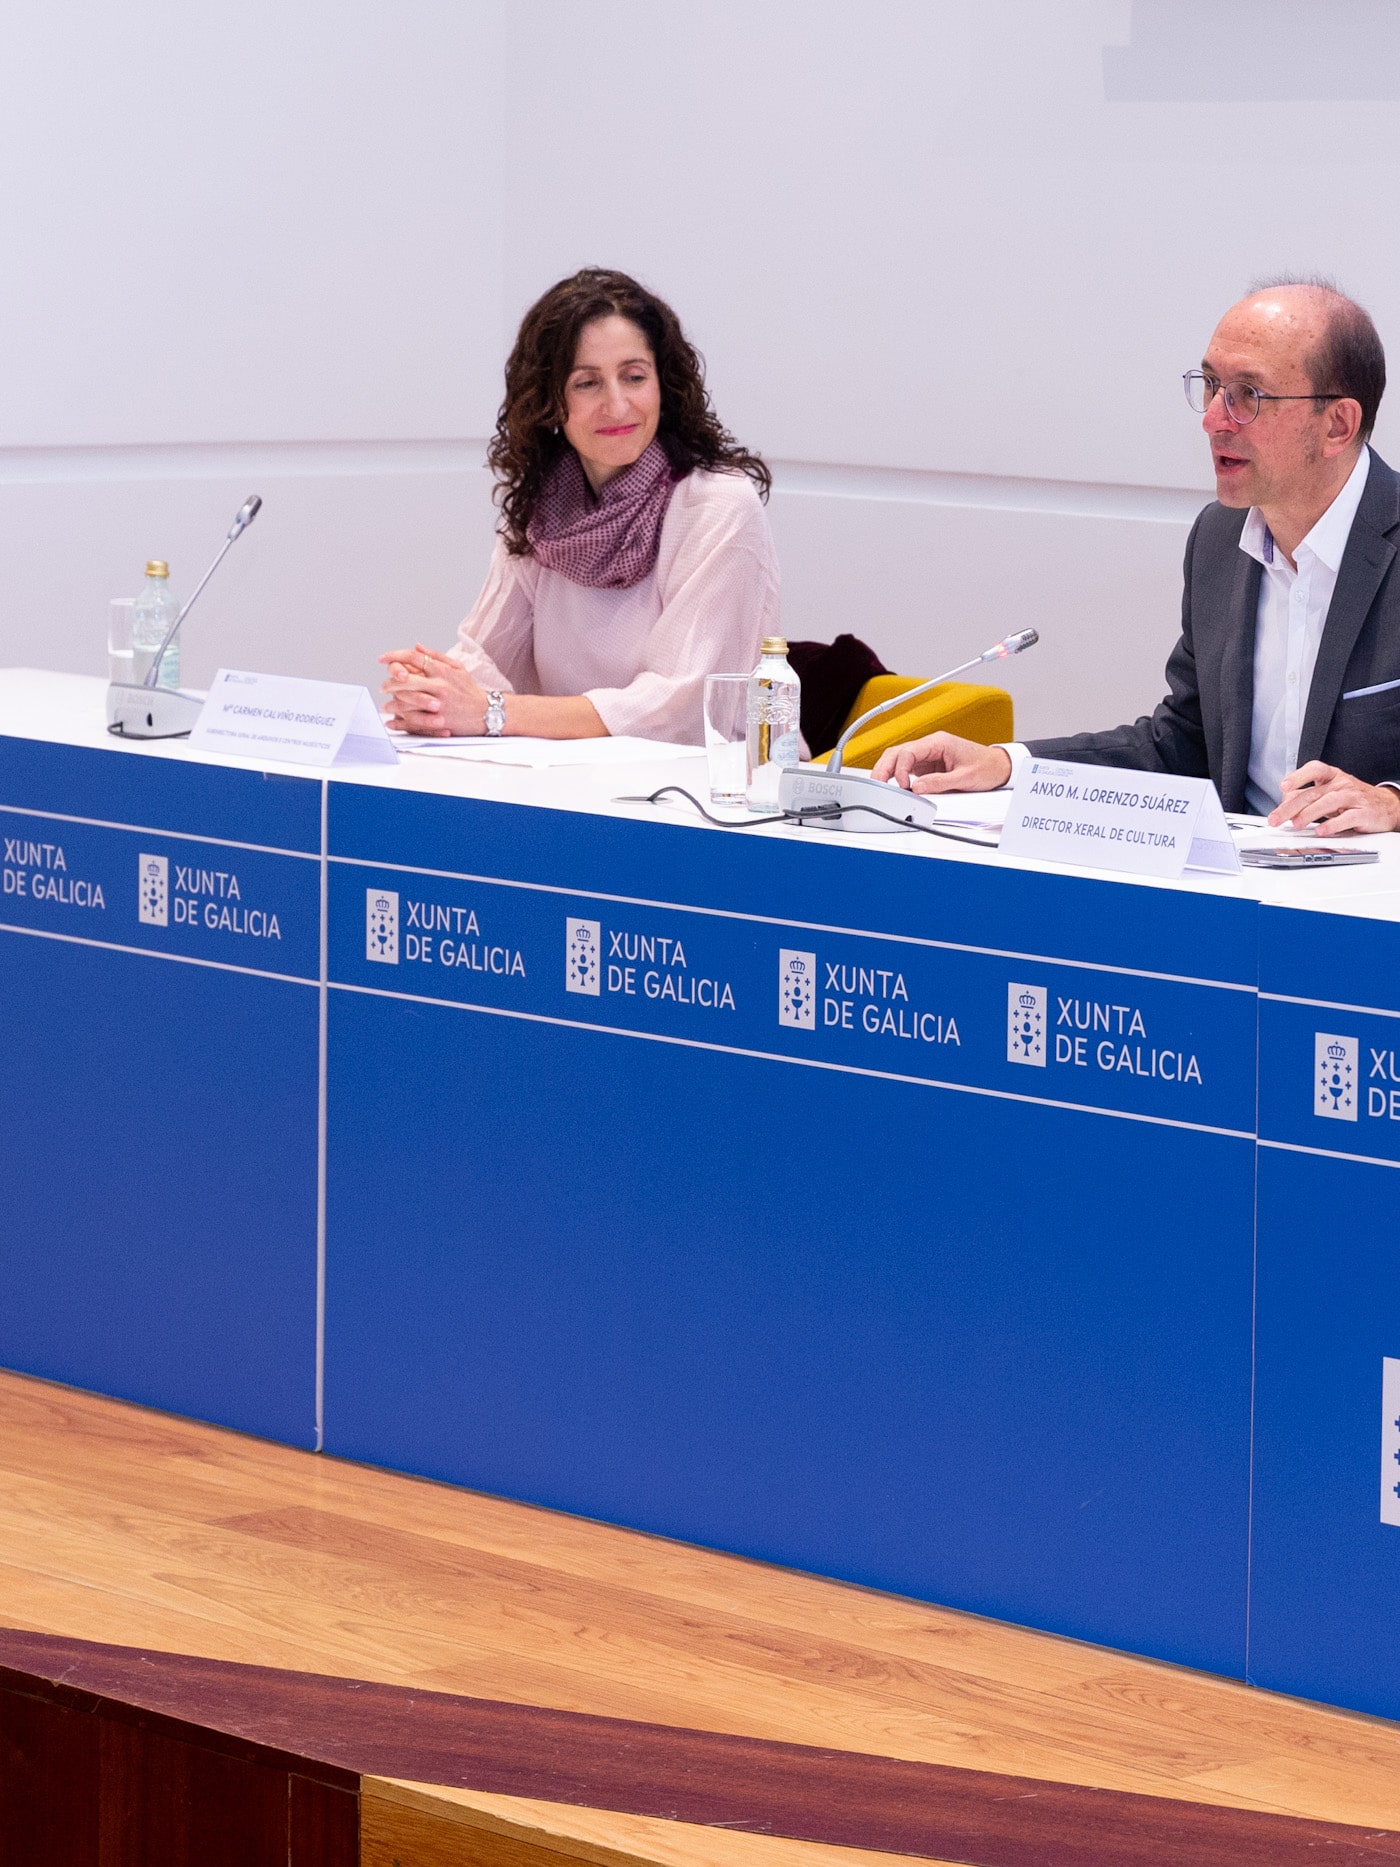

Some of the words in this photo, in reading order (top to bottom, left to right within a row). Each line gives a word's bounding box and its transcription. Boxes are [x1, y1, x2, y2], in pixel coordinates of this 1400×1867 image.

[233, 705, 263, 718] CARMEN
[263, 708, 295, 722] CALVIÑO
[294, 712, 337, 727] RODRÍGUEZ
[808, 782, 843, 797] BOSCH
[1030, 781, 1065, 798] ANXO
[1066, 785, 1079, 800] M.
[1082, 787, 1139, 808] LORENZO
[1140, 793, 1190, 815] SUÁREZ
[1021, 815, 1072, 834] DIRECTOR
[1073, 822, 1107, 839] XERAL
[1109, 827, 1124, 841] DE
[1125, 829, 1176, 849] CULTURA
[4, 838, 67, 872] XUNTA
[3, 868, 27, 896] DE
[31, 873, 106, 909] GALICIA
[175, 865, 241, 900] XUNTA
[174, 897, 198, 926] DE
[204, 902, 281, 940] GALICIA
[406, 901, 480, 937] XUNTA
[406, 934, 433, 963] DE
[439, 939, 526, 978] GALICIA
[609, 930, 687, 968] XUNTA
[608, 965, 636, 995] DE
[643, 970, 736, 1011] GALICIA
[825, 962, 909, 1002] XUNTA
[824, 998, 854, 1029] DE
[862, 1004, 961, 1046] GALICIA
[1056, 997, 1147, 1038] XUNTA
[1055, 1034, 1088, 1066] DE
[1096, 1040, 1203, 1085] GALICIA
